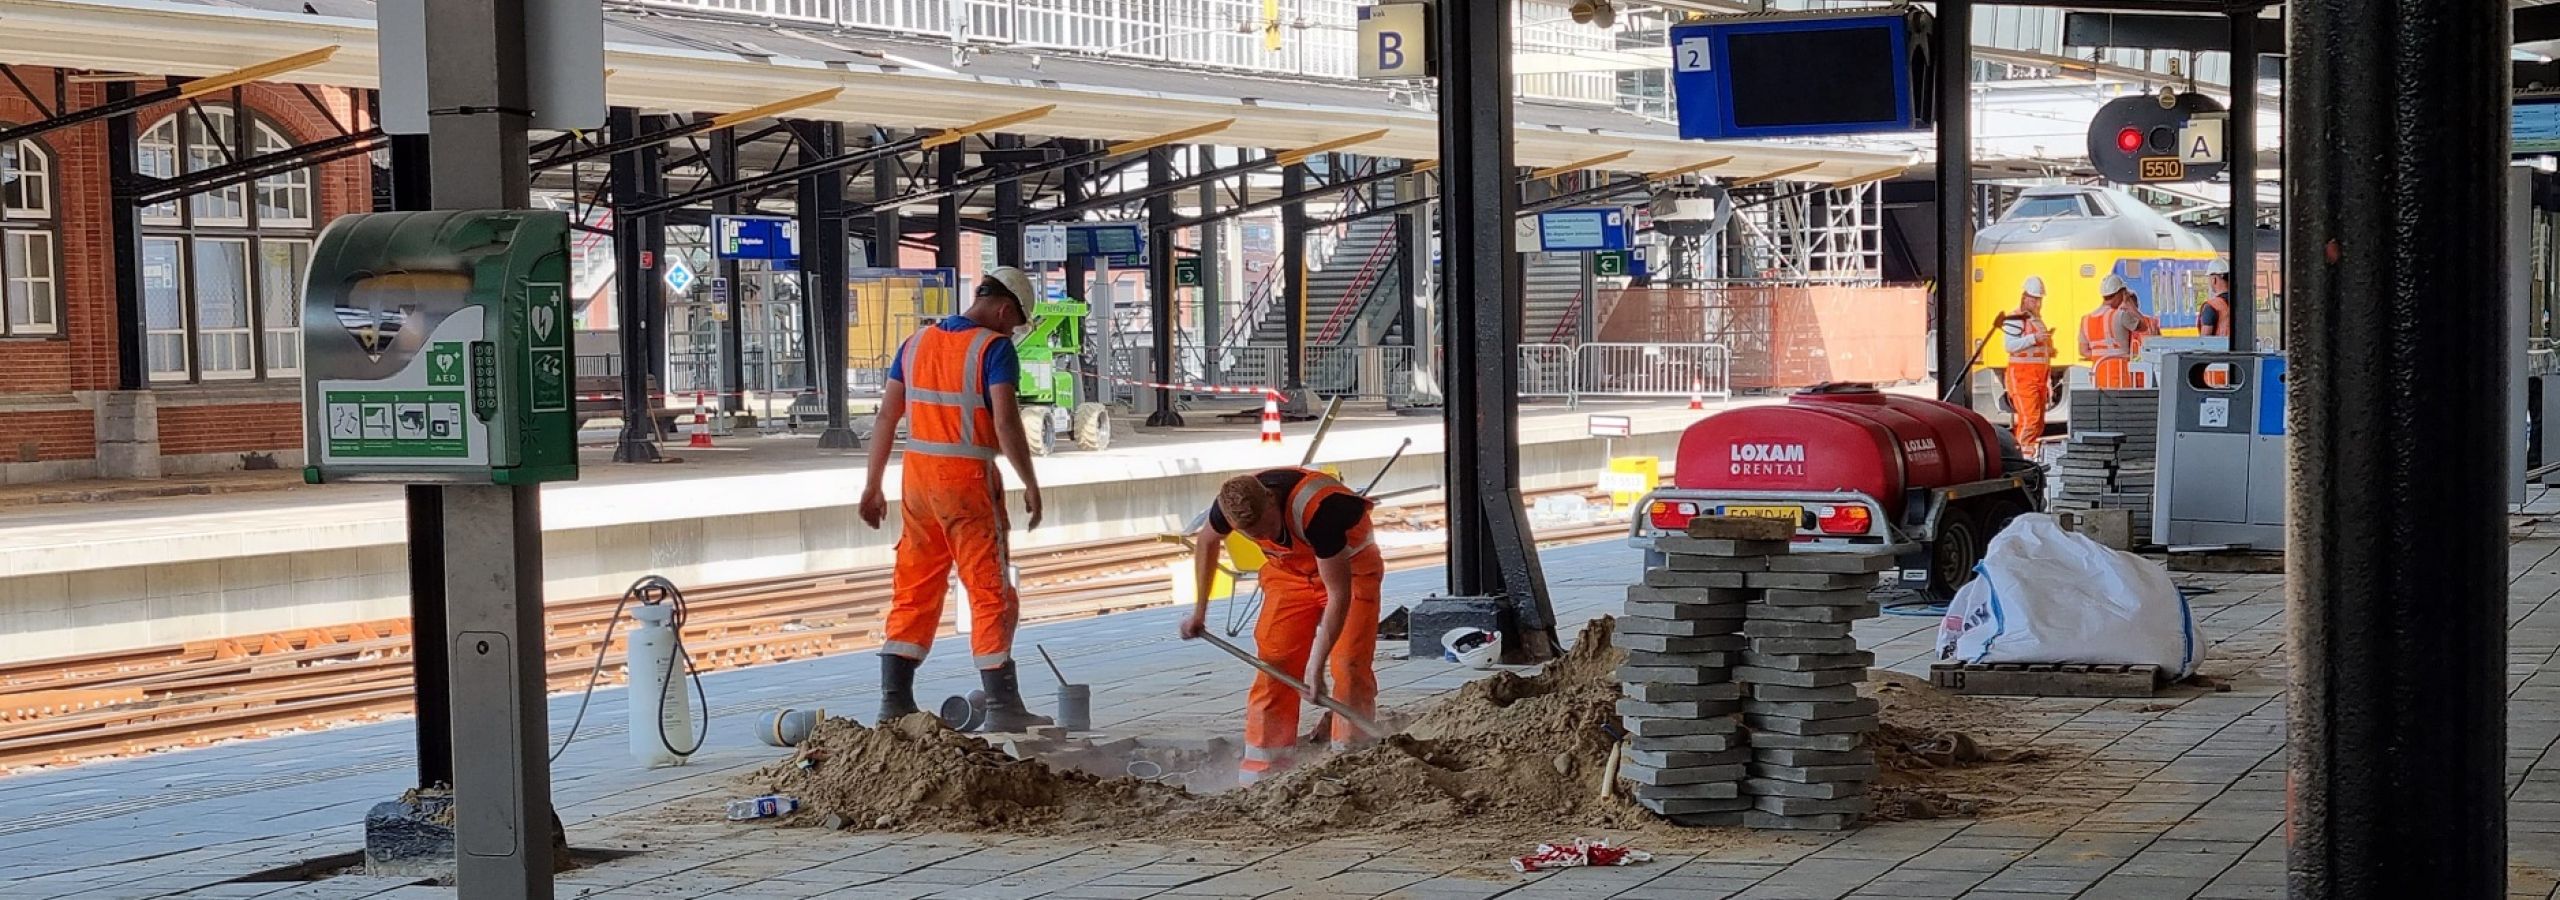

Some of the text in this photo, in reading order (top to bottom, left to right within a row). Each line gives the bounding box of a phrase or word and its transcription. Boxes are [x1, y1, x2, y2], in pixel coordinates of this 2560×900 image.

[1379, 31, 1404, 70] B
[1688, 50, 1700, 68] 2
[2190, 135, 2211, 158] A
[2146, 161, 2179, 177] 5510
[672, 272, 685, 283] 12
[435, 374, 457, 382] AED
[1731, 444, 1805, 461] LOXAM
[1904, 438, 1936, 452] LOXAM
[1743, 464, 1804, 475] RENTAL
